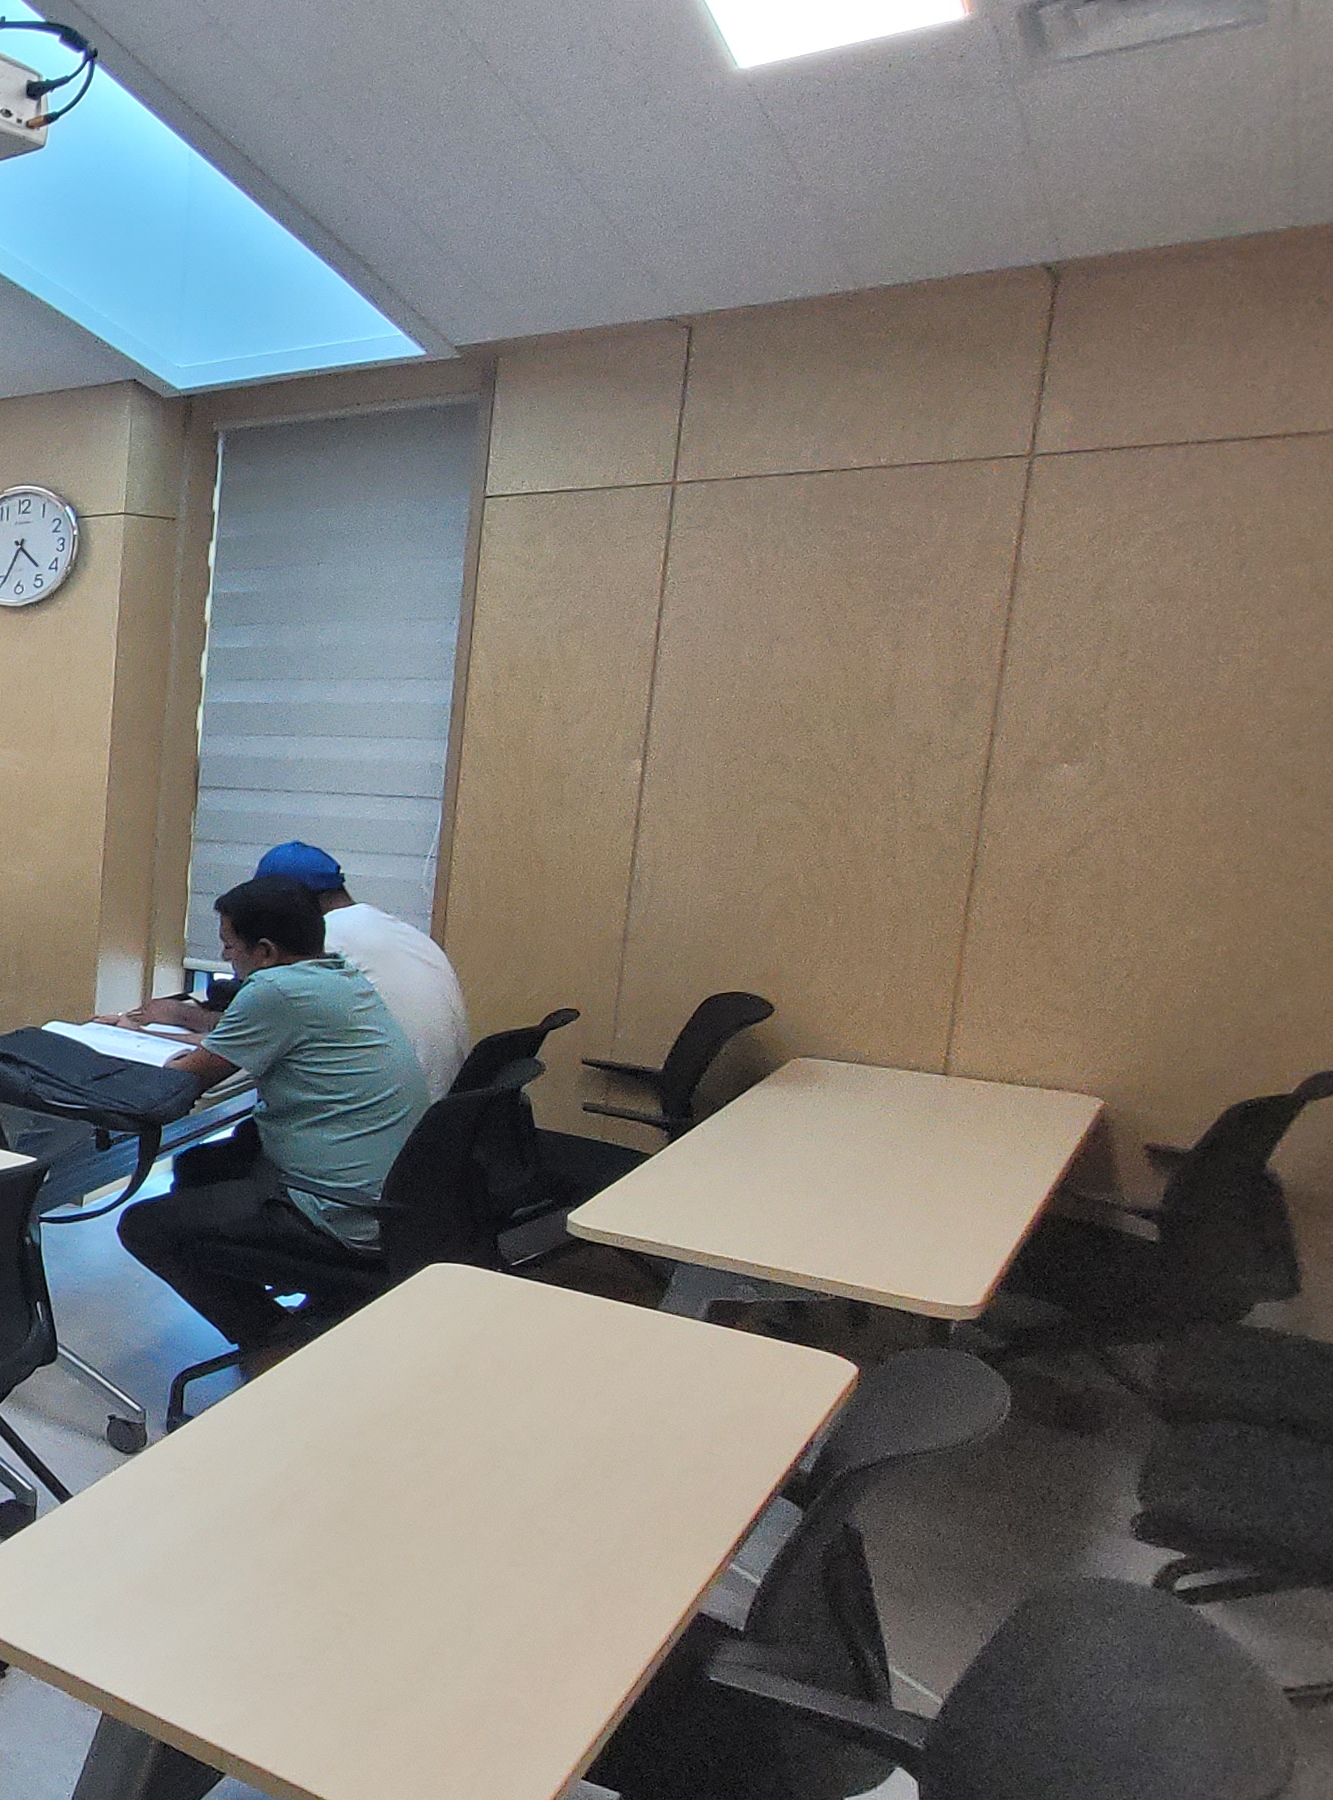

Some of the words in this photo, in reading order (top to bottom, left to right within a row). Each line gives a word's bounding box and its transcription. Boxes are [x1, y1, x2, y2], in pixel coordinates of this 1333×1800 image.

[0, 506, 10, 521] 11
[18, 498, 31, 515] 12
[52, 518, 62, 533] 2
[56, 537, 66, 552] 3
[48, 557, 59, 572] 4
[14, 580, 24, 595] 6
[33, 574, 44, 589] 5
